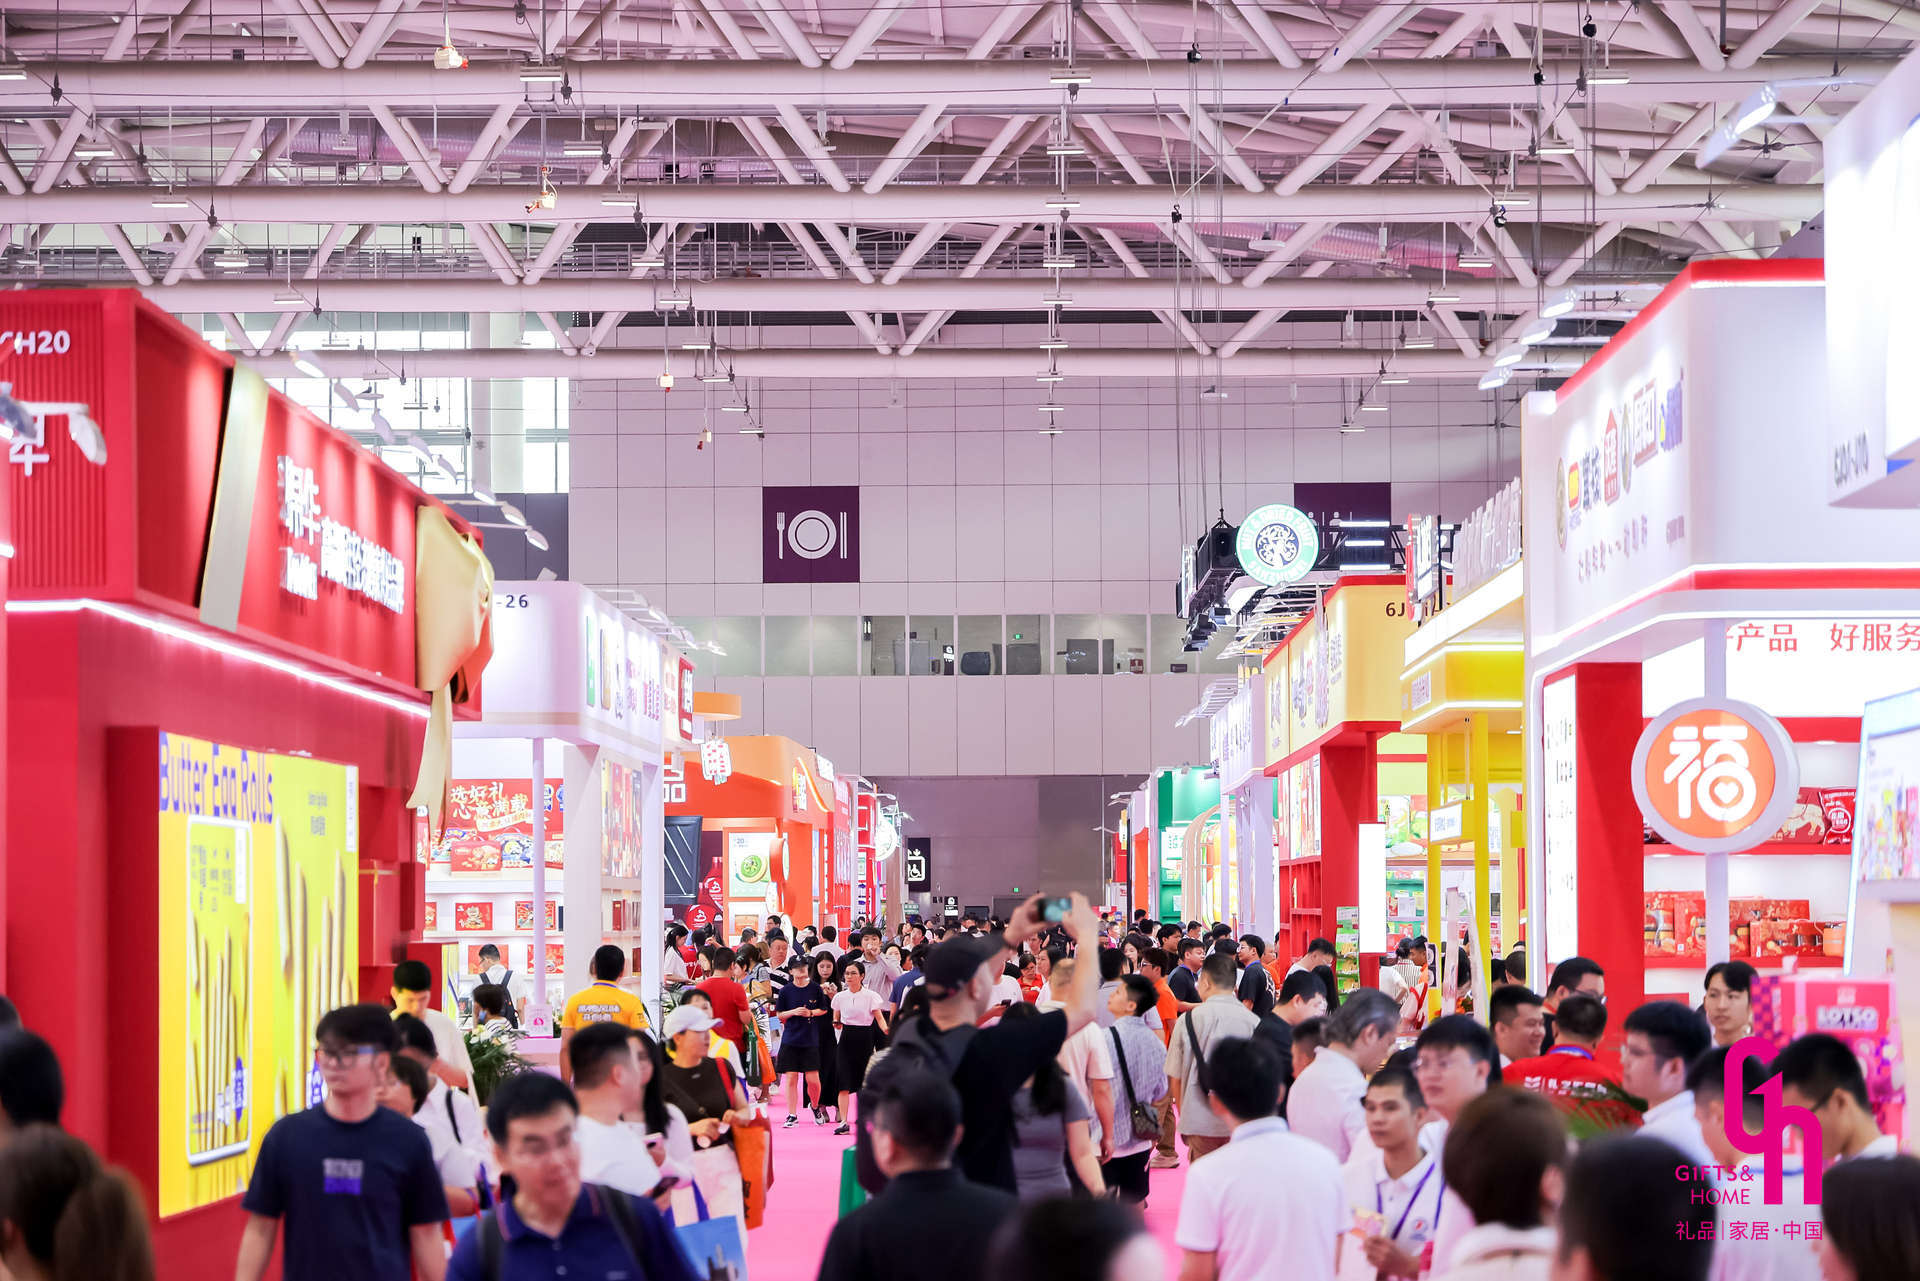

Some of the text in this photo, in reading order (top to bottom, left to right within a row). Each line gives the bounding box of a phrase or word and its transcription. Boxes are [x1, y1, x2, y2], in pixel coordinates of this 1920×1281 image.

[1830, 622, 1920, 652] 好服务
[160, 731, 207, 816] Butter
[241, 749, 273, 824] Rolls
[1664, 725, 1756, 823] 福
